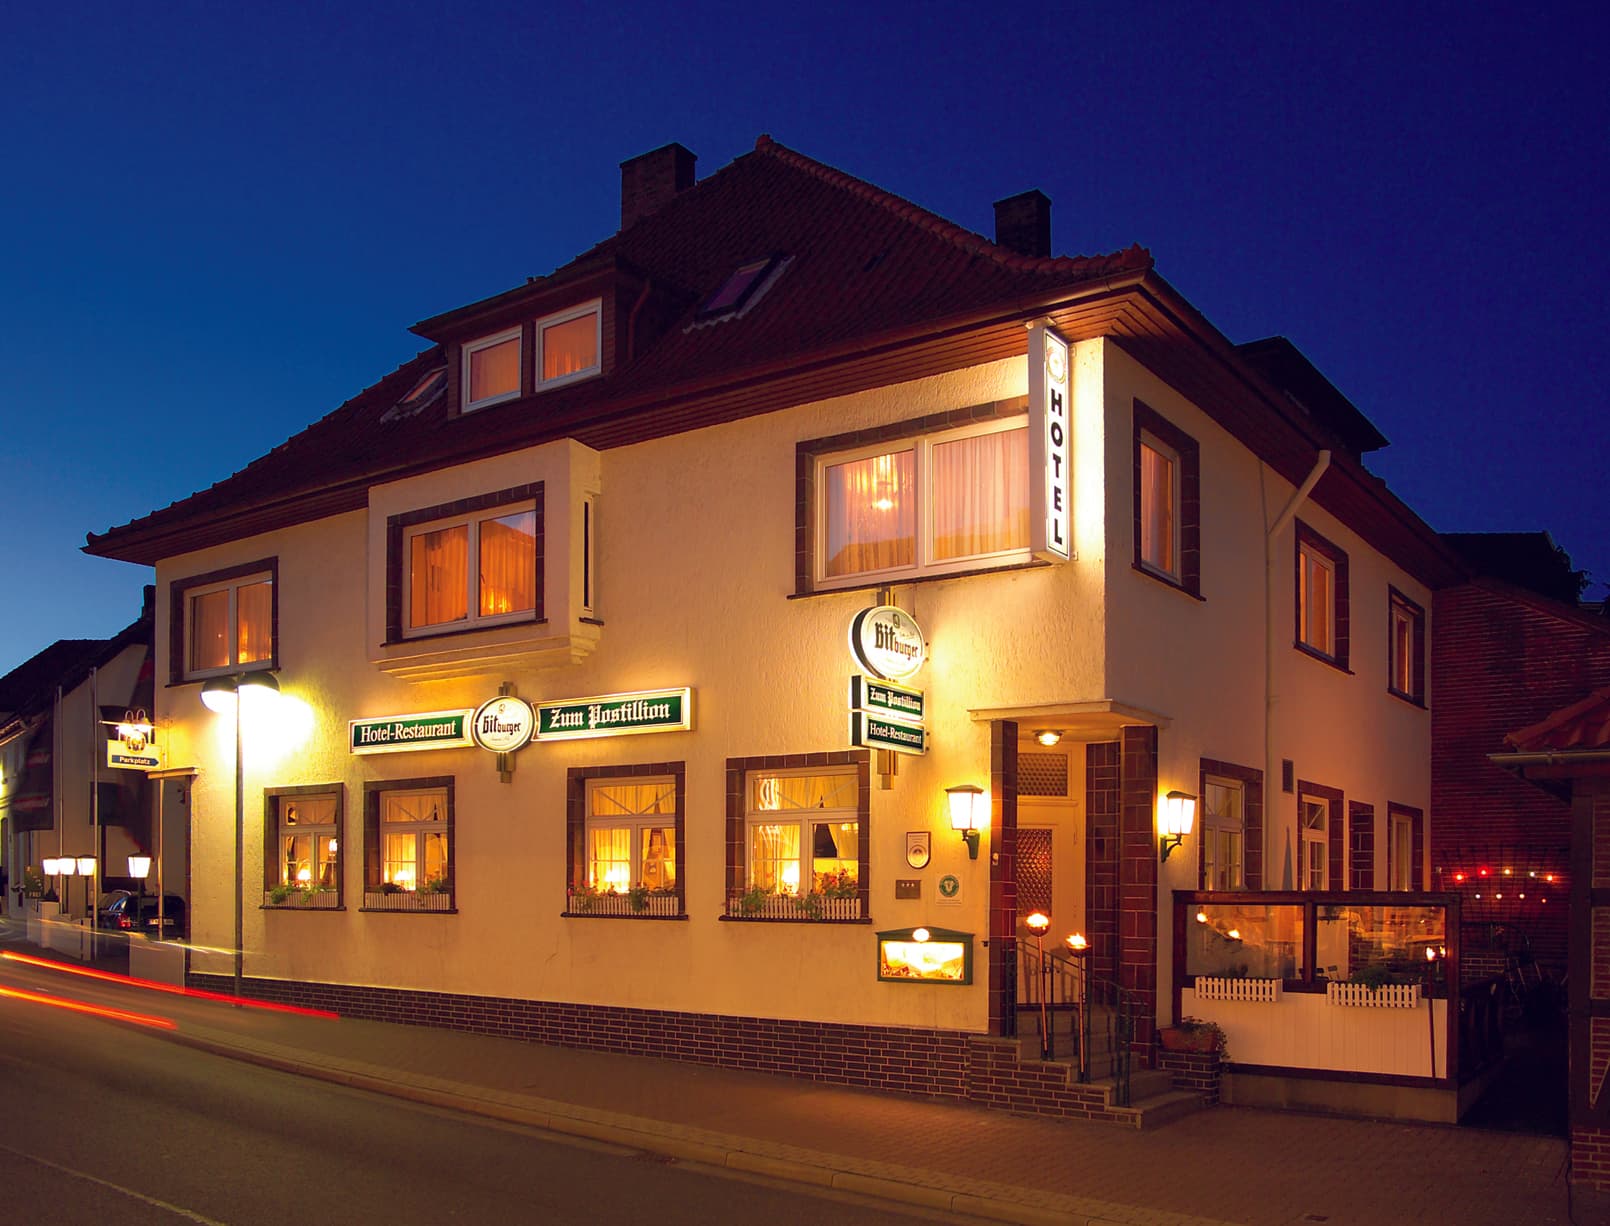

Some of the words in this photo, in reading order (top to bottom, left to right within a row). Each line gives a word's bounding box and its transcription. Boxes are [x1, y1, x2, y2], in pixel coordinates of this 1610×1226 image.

[1051, 388, 1063, 545] HOTEL
[874, 621, 919, 662] Bitburger
[870, 686, 887, 703] Zum
[482, 714, 522, 736] Bitburger
[549, 708, 584, 729] Zum
[587, 700, 671, 729] Postillion
[360, 720, 457, 743] Hotel-Restaurant
[870, 722, 922, 745] Hotel-Restaurant
[119, 756, 151, 766] Parkplatz
